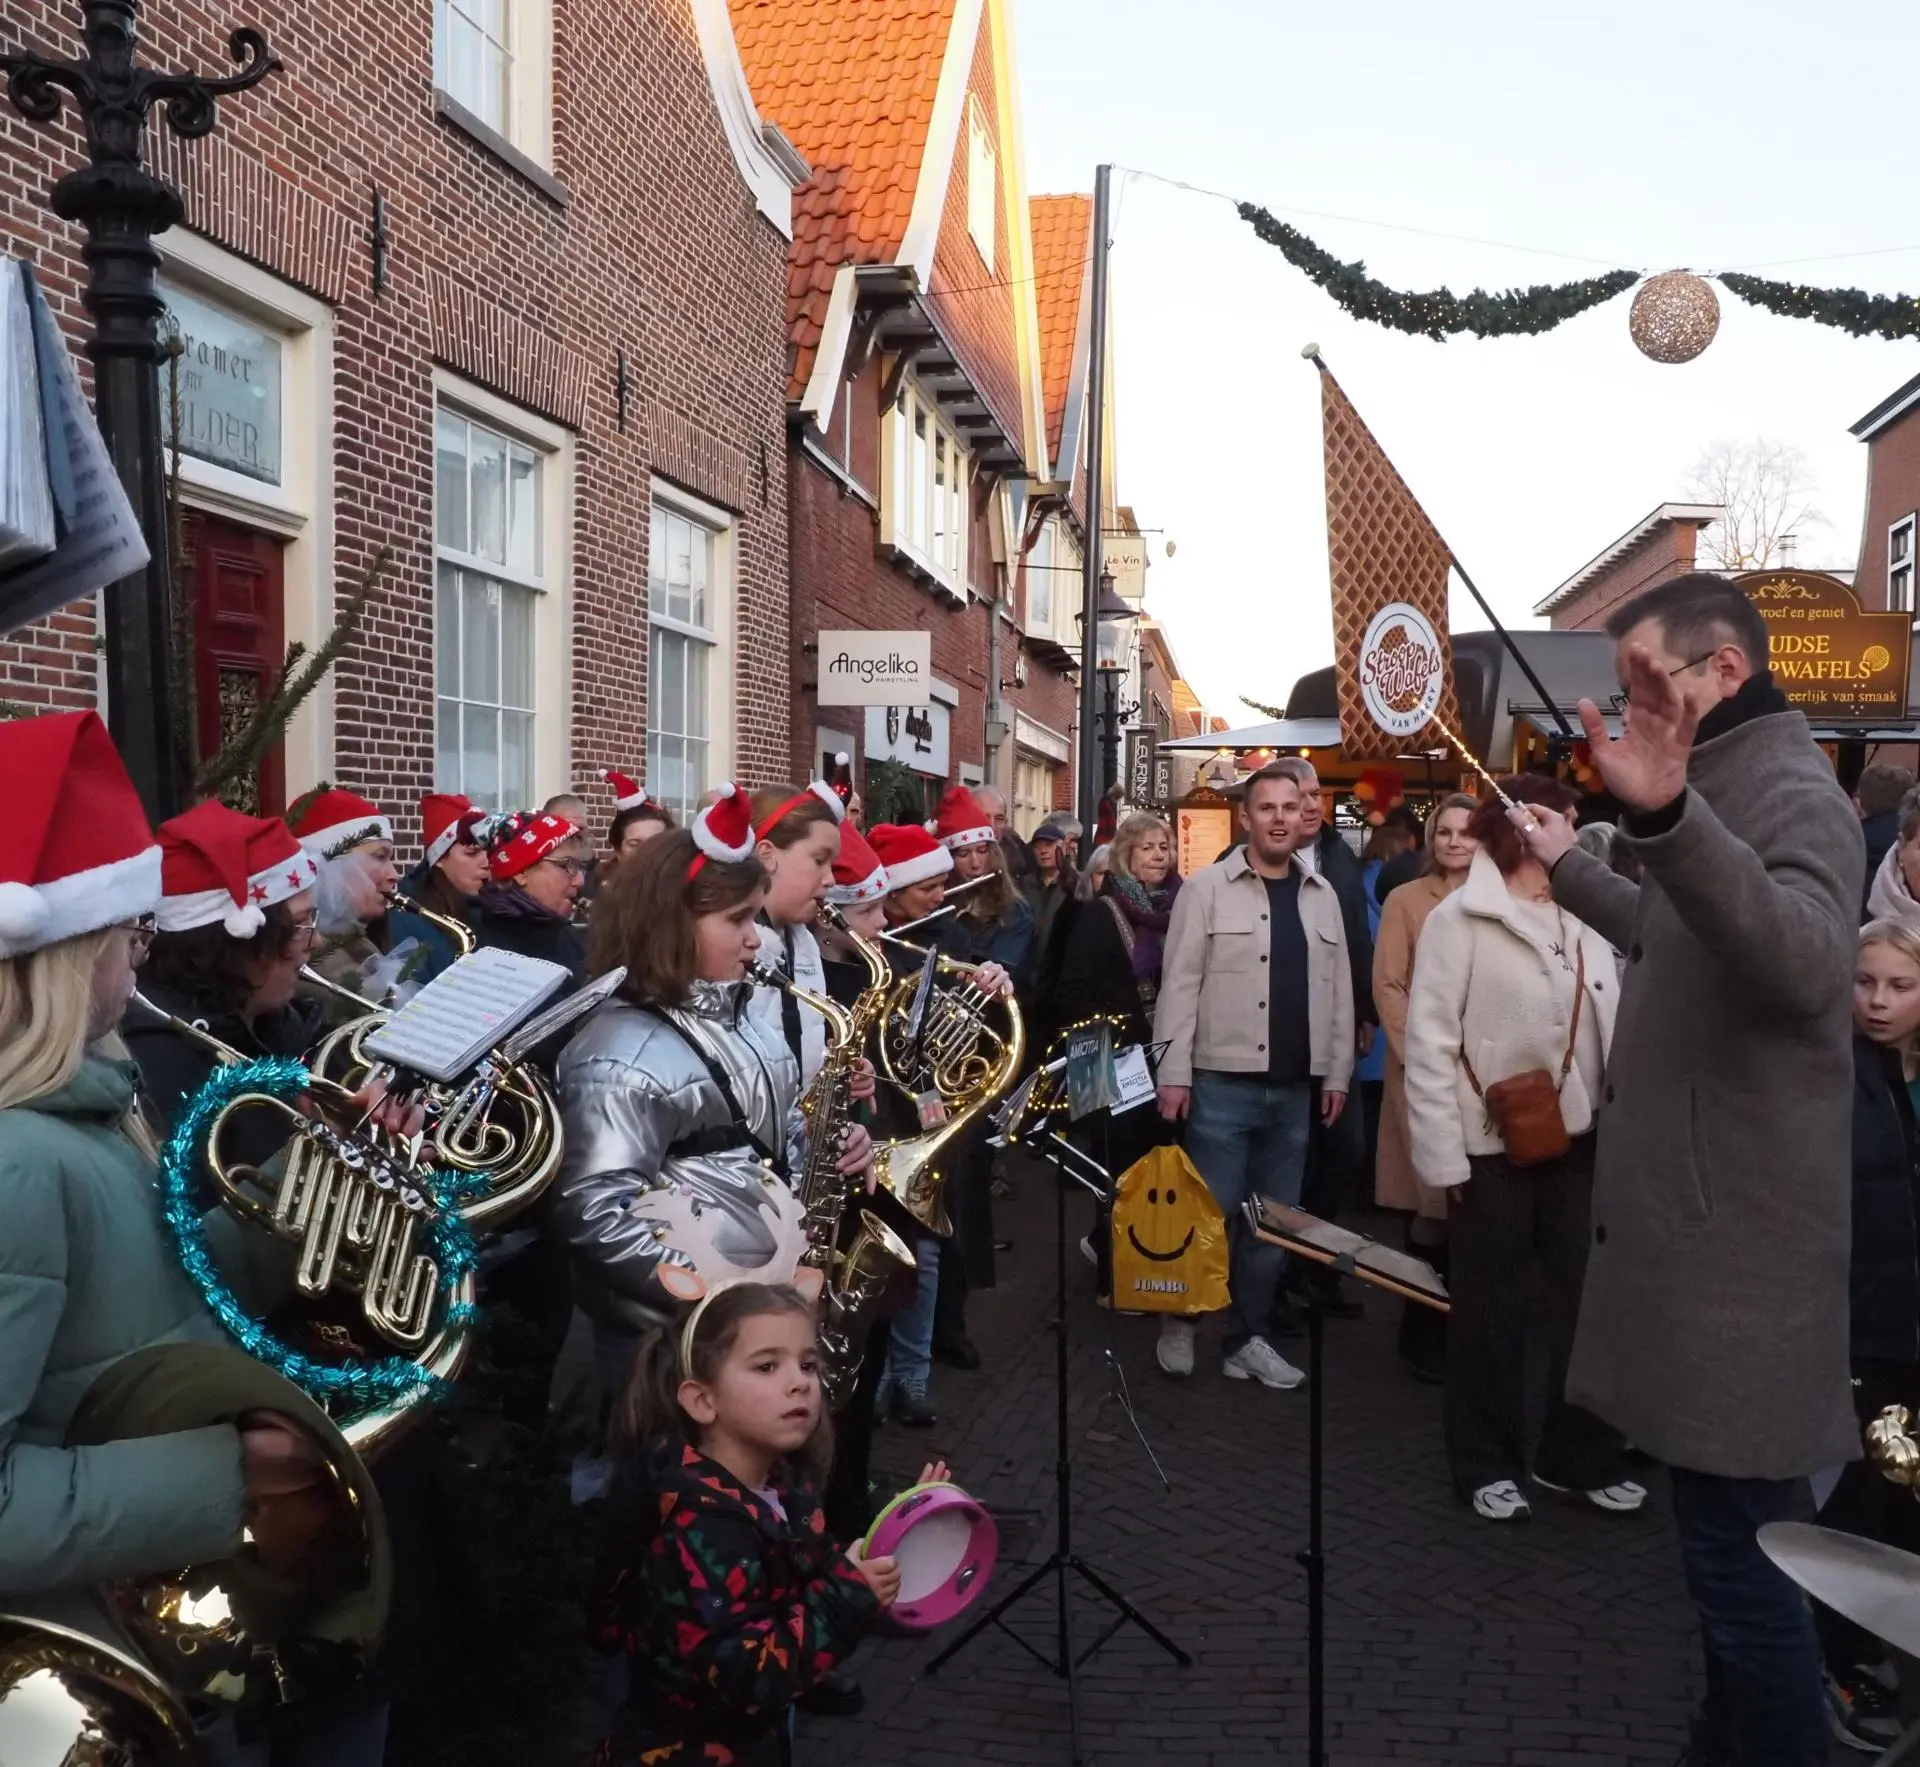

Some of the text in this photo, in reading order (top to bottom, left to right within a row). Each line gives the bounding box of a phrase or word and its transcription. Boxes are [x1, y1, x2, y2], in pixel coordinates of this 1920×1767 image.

[1122, 555, 1140, 565] Vin
[1758, 606, 1845, 621] roef en geniet
[1768, 635, 1830, 654] UDSE
[829, 652, 918, 684] Angelika
[1362, 641, 1417, 685] Stroop
[1768, 660, 1871, 680] PWAFELS
[1379, 646, 1440, 704] Wafels
[1788, 690, 1897, 704] eerlijk van smaak
[1391, 717, 1410, 729] VAN
[1133, 1277, 1189, 1295] JUMBO
